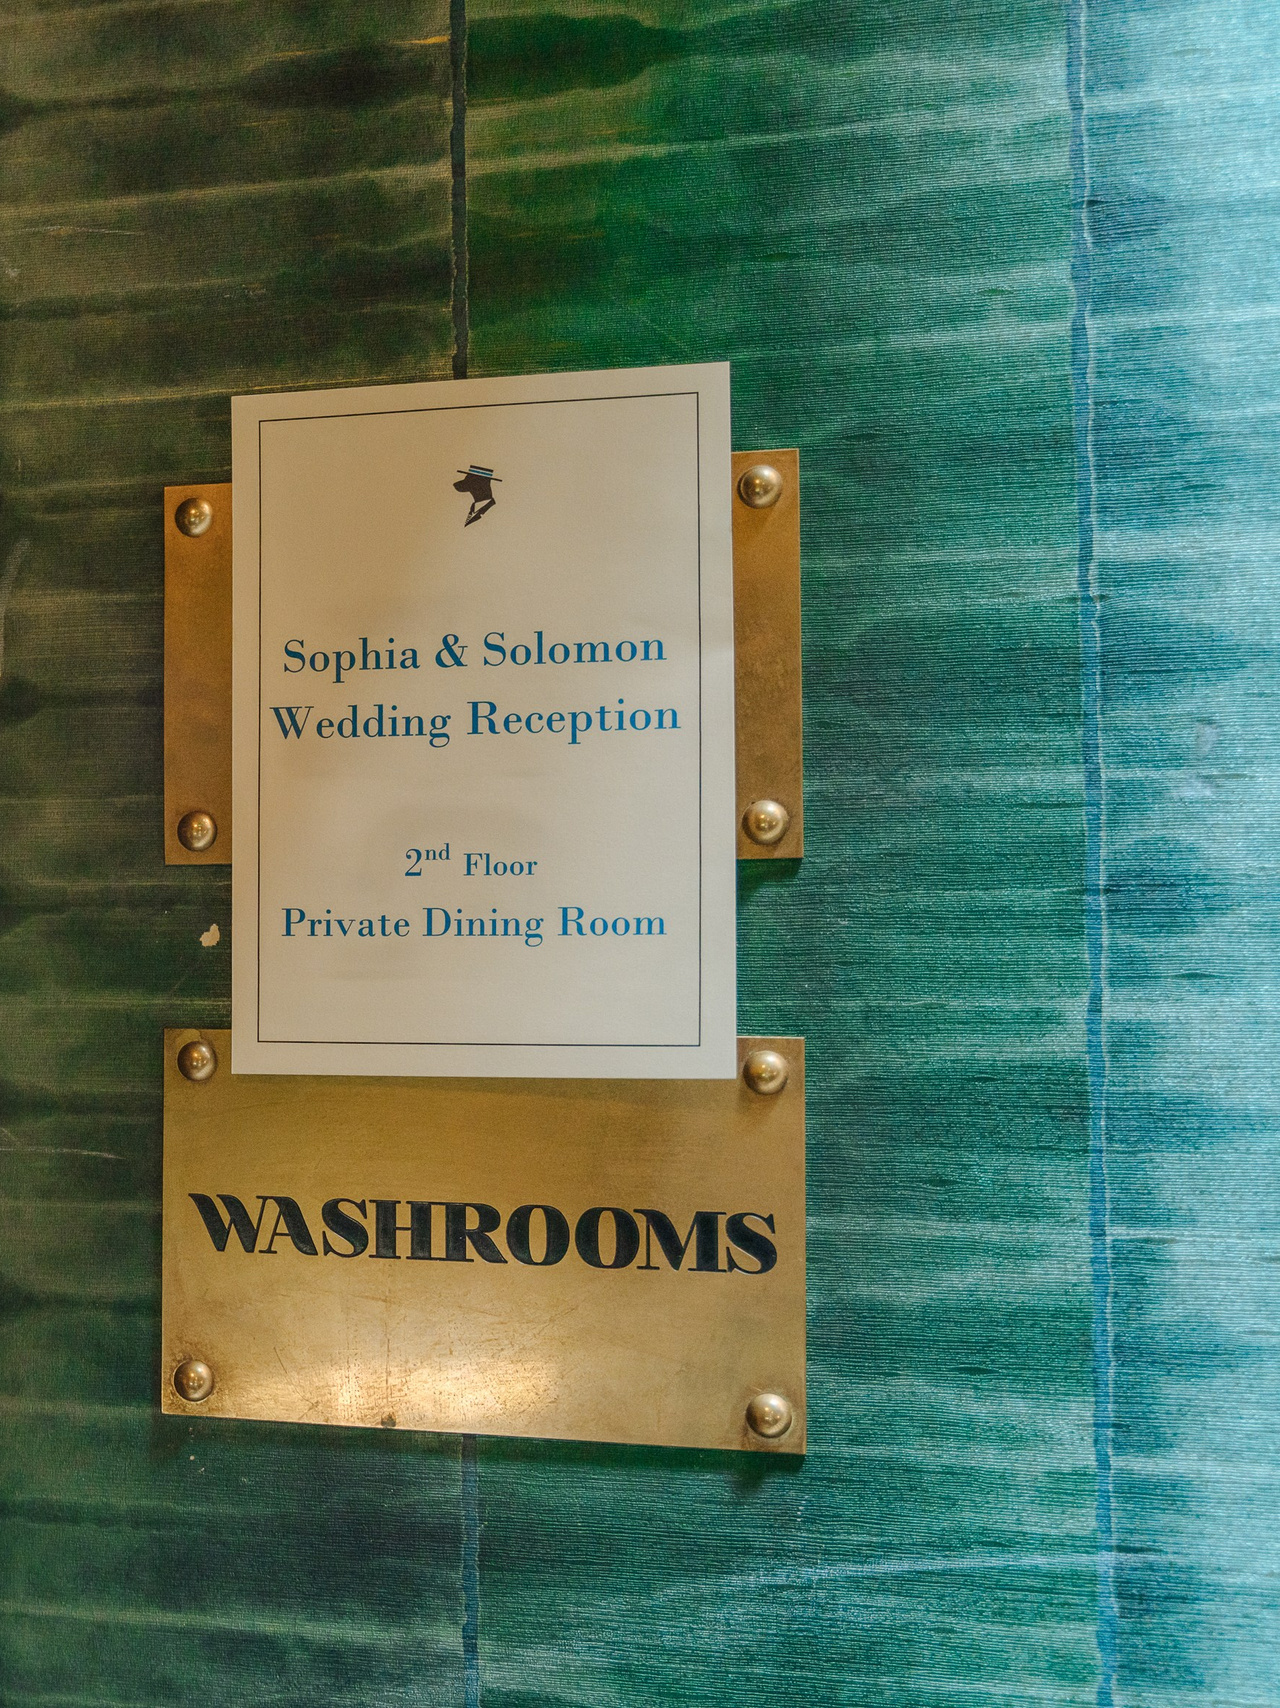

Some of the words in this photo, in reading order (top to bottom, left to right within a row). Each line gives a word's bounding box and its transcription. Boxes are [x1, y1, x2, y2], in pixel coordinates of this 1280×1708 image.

[283, 637, 421, 683] Sophia
[434, 633, 468, 668] &
[482, 630, 667, 667] Solomon
[270, 704, 451, 748] Wedding
[466, 697, 681, 745] Reception
[404, 843, 451, 877] 2nd
[463, 852, 538, 876] Floor
[281, 907, 410, 938] Private
[422, 907, 544, 947] Dining
[557, 906, 667, 936] Room
[187, 1192, 778, 1275] WASHROOMS
